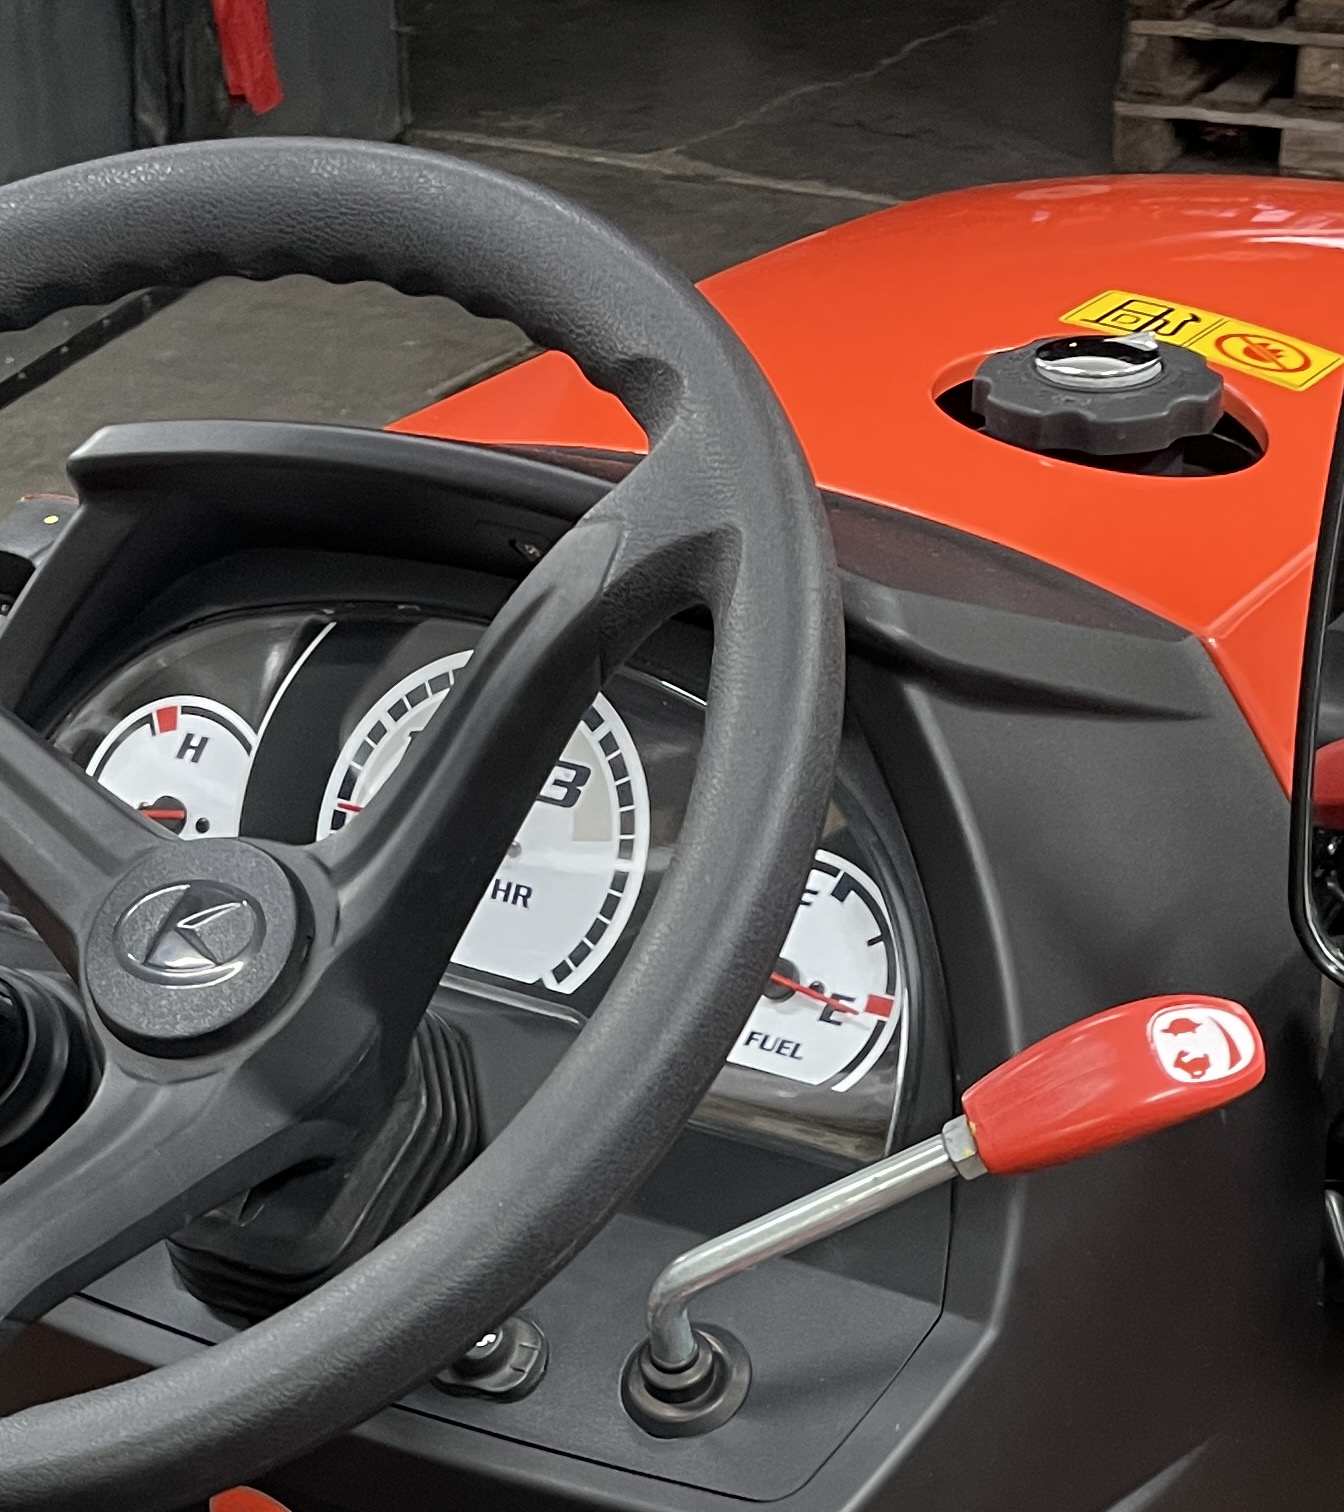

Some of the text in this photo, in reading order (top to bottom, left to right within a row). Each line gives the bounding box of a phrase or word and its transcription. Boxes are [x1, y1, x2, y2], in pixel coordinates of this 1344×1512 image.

[175, 733, 209, 763] H
[491, 878, 533, 909] HR
[818, 993, 855, 1026] E
[743, 1030, 804, 1060] FUEL
